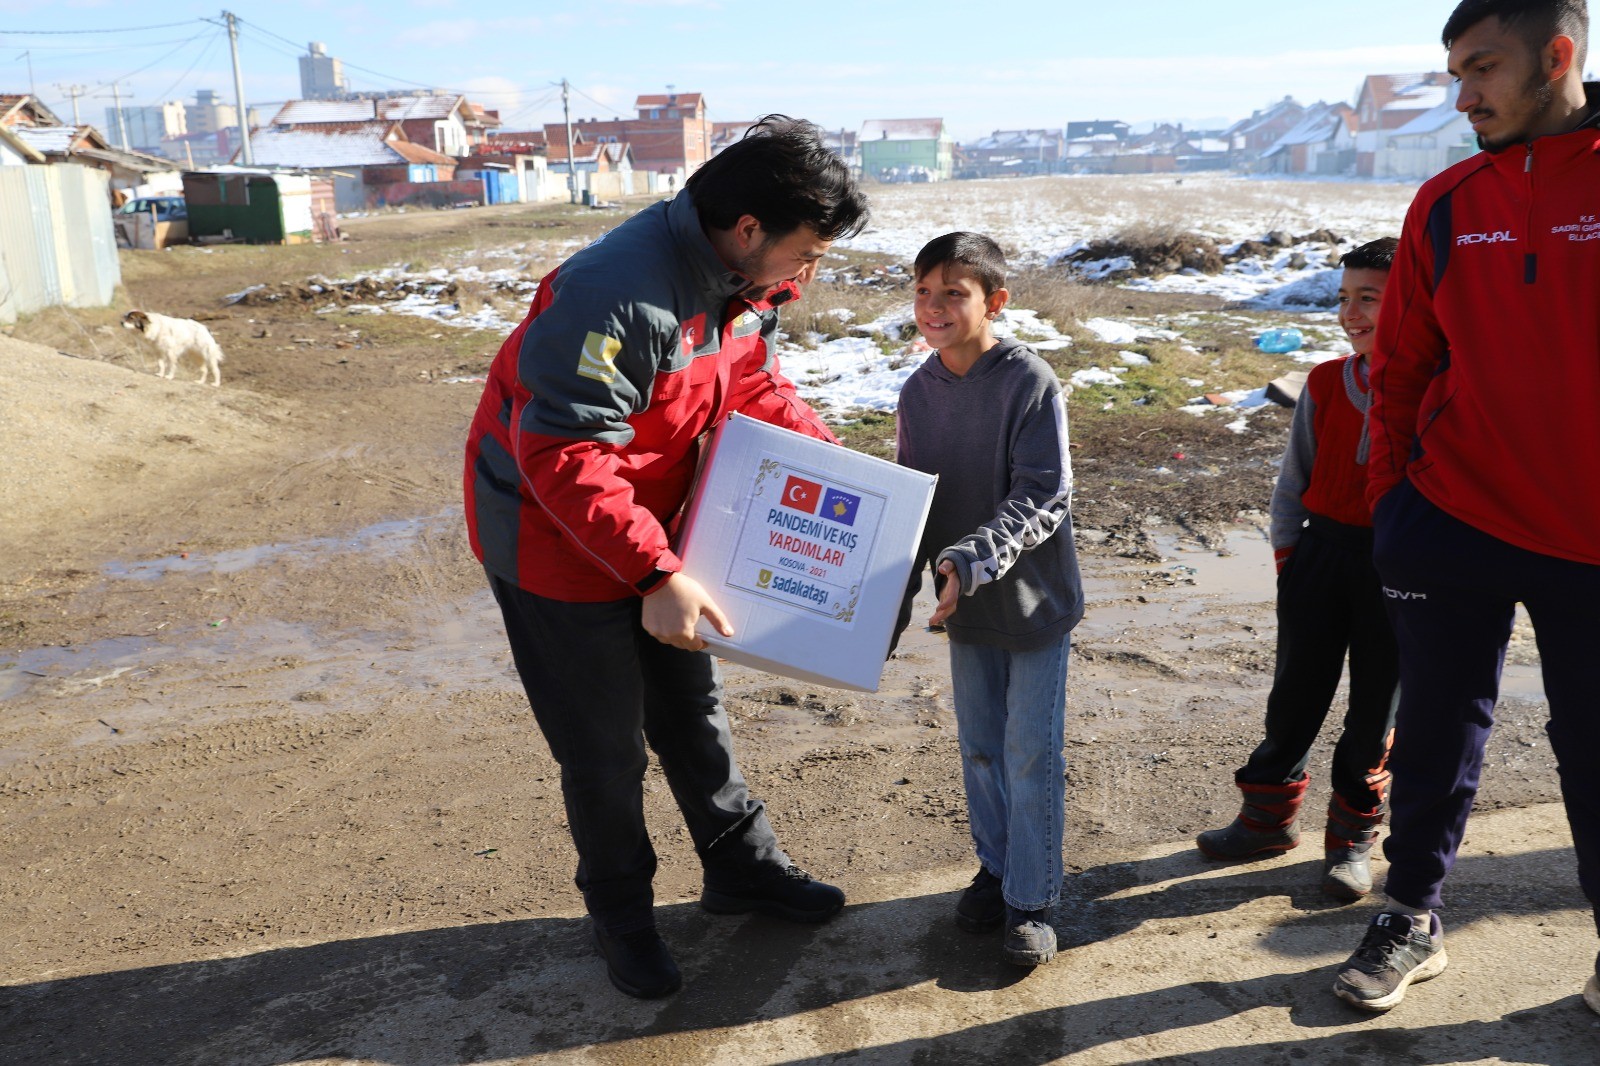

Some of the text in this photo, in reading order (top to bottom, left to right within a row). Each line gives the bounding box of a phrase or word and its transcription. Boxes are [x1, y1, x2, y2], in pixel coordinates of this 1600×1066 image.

[1456, 230, 1518, 246] ROYAL
[1551, 224, 1580, 234] SADRI
[767, 508, 859, 553] PANDEMİ VE KIŞ
[769, 530, 845, 567] YARDIMLARI
[778, 556, 805, 572] KOSOVA
[809, 565, 827, 578] 2021
[771, 575, 829, 605] sadakataşı
